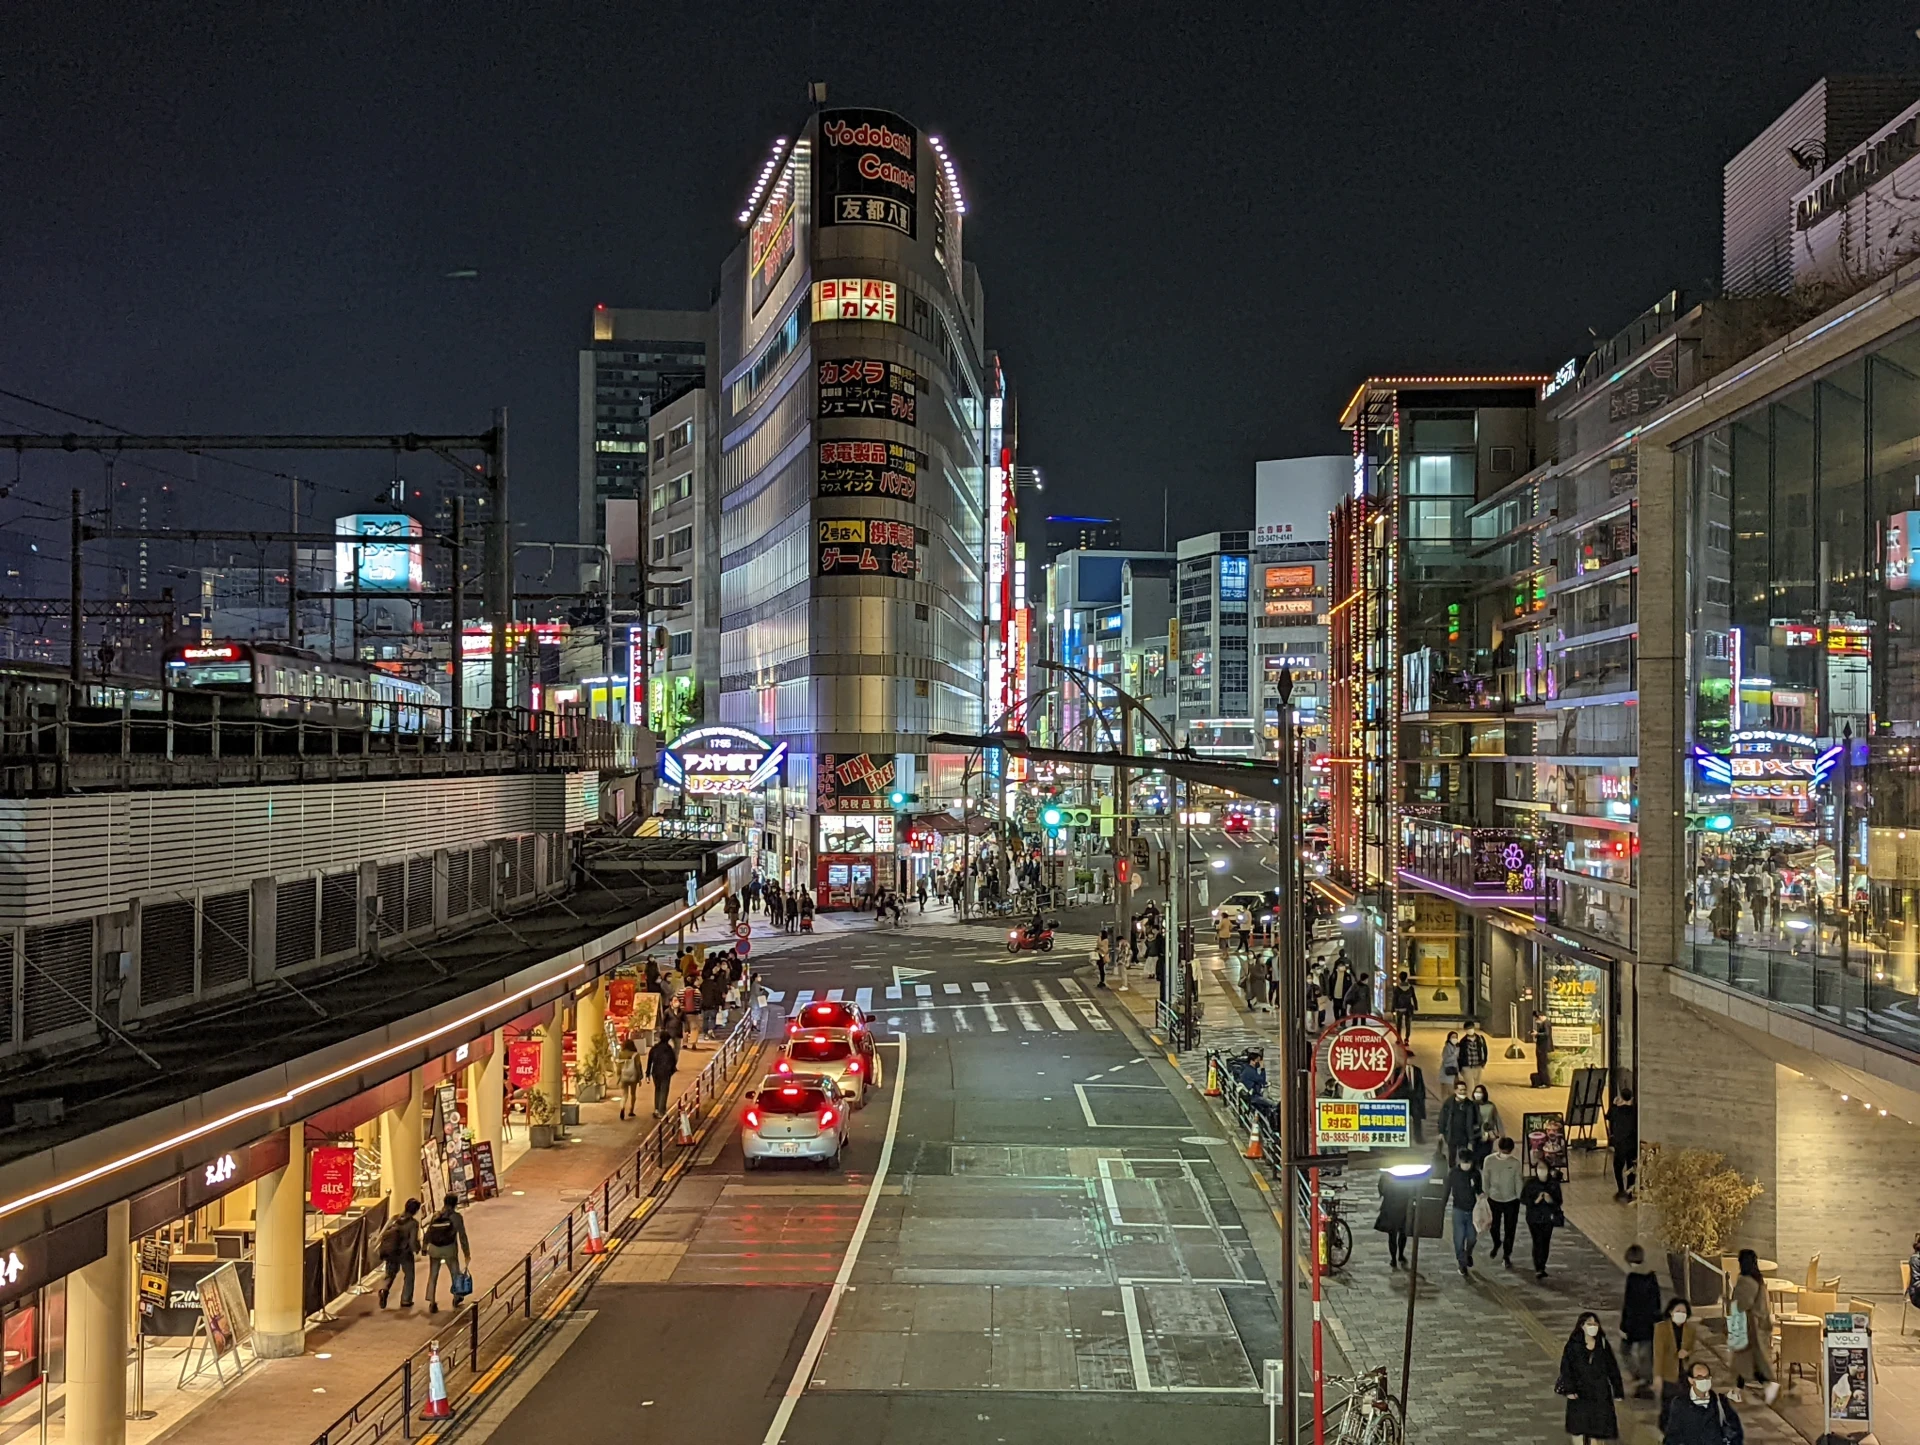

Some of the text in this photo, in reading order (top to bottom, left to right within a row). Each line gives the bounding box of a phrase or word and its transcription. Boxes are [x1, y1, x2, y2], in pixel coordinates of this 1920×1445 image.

[824, 120, 912, 160] Yodobashi
[858, 153, 916, 193] Camera
[842, 199, 908, 230] 友都八喜
[821, 280, 895, 300] ヨドバシ
[841, 301, 895, 319] カメラ
[820, 361, 885, 384] カメラ
[845, 387, 888, 398] ドライヤー
[821, 399, 886, 414] シェーバー
[891, 393, 915, 422] テレビ
[820, 442, 887, 465] 家電製品
[820, 469, 874, 480] スーツケース
[879, 470, 915, 498] パソコン
[820, 481, 874, 492] マウス インク
[820, 523, 862, 541] 2号店へ
[822, 548, 879, 571] ゲーム
[836, 753, 876, 786] TAX
[863, 761, 896, 793] FREE
[1340, 1035, 1382, 1043] FIRE HYDRANT
[1335, 1046, 1388, 1072] 消火栓
[1322, 1103, 1357, 1115] 中国語
[1327, 1117, 1352, 1129] 対応
[321, 1182, 344, 1194] atré
